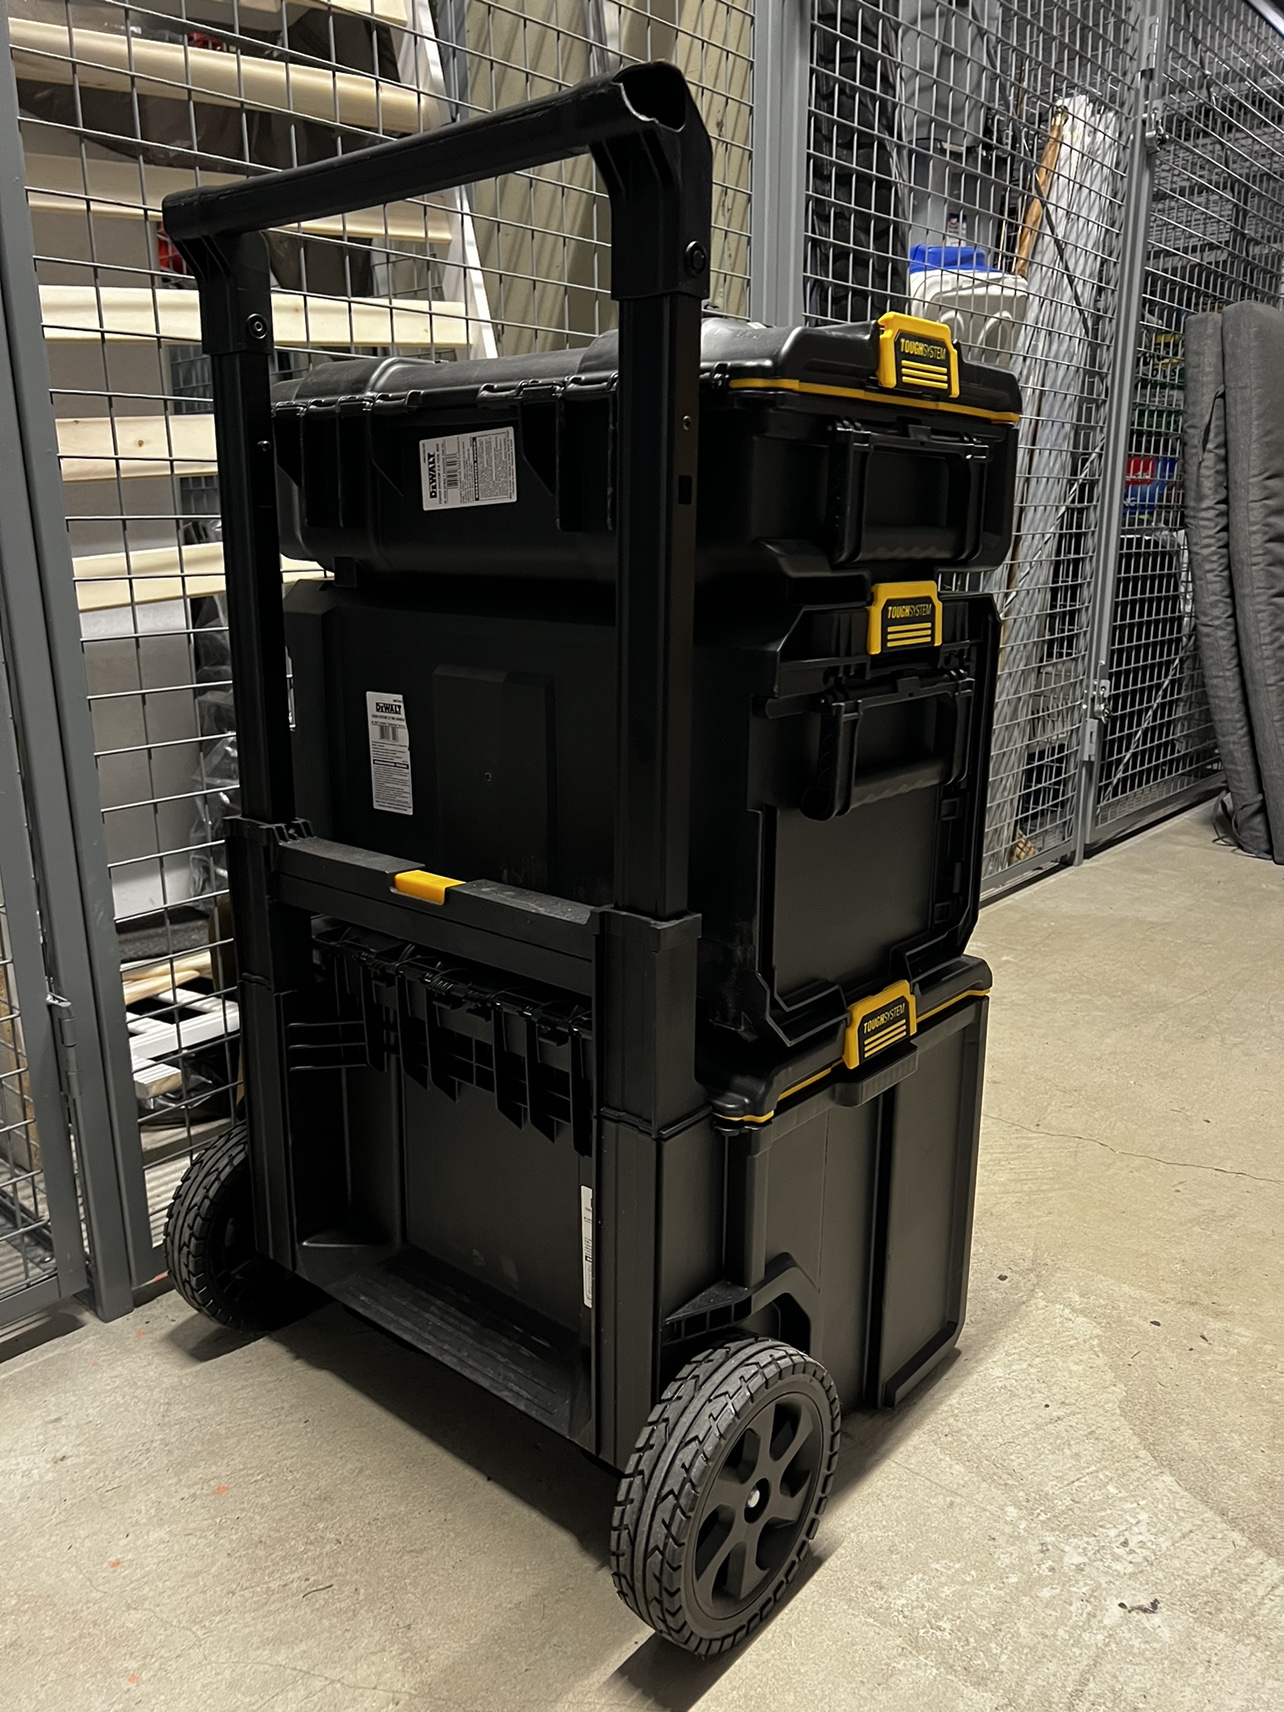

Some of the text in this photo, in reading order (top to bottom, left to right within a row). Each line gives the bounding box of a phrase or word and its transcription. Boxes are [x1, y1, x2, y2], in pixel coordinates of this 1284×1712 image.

[900, 338, 947, 360] TOUGHSYSTEM
[887, 603, 932, 619] TOUGHSYSTEM
[863, 1003, 905, 1034] TOUGHSYSTEM
